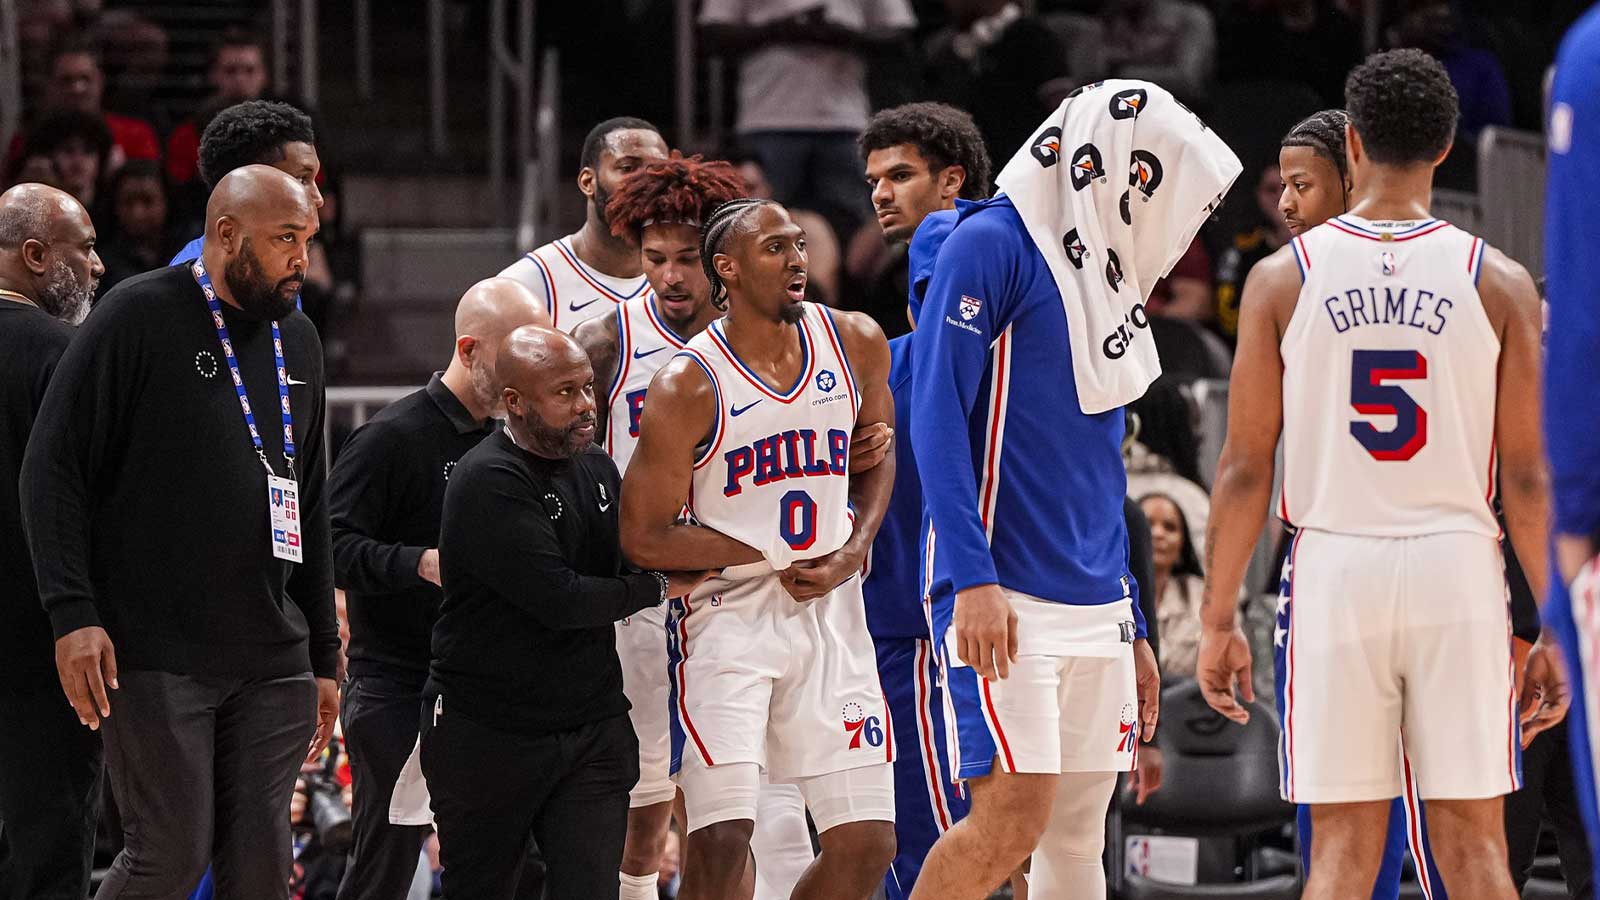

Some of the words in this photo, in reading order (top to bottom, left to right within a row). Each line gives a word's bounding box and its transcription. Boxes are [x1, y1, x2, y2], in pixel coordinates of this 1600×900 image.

[1325, 287, 1453, 335] GRIMES
[812, 393, 848, 407] crypto.com
[1350, 349, 1427, 461] 5
[780, 490, 817, 550] 0
[844, 715, 884, 750] 76
[1117, 720, 1136, 753] 76
